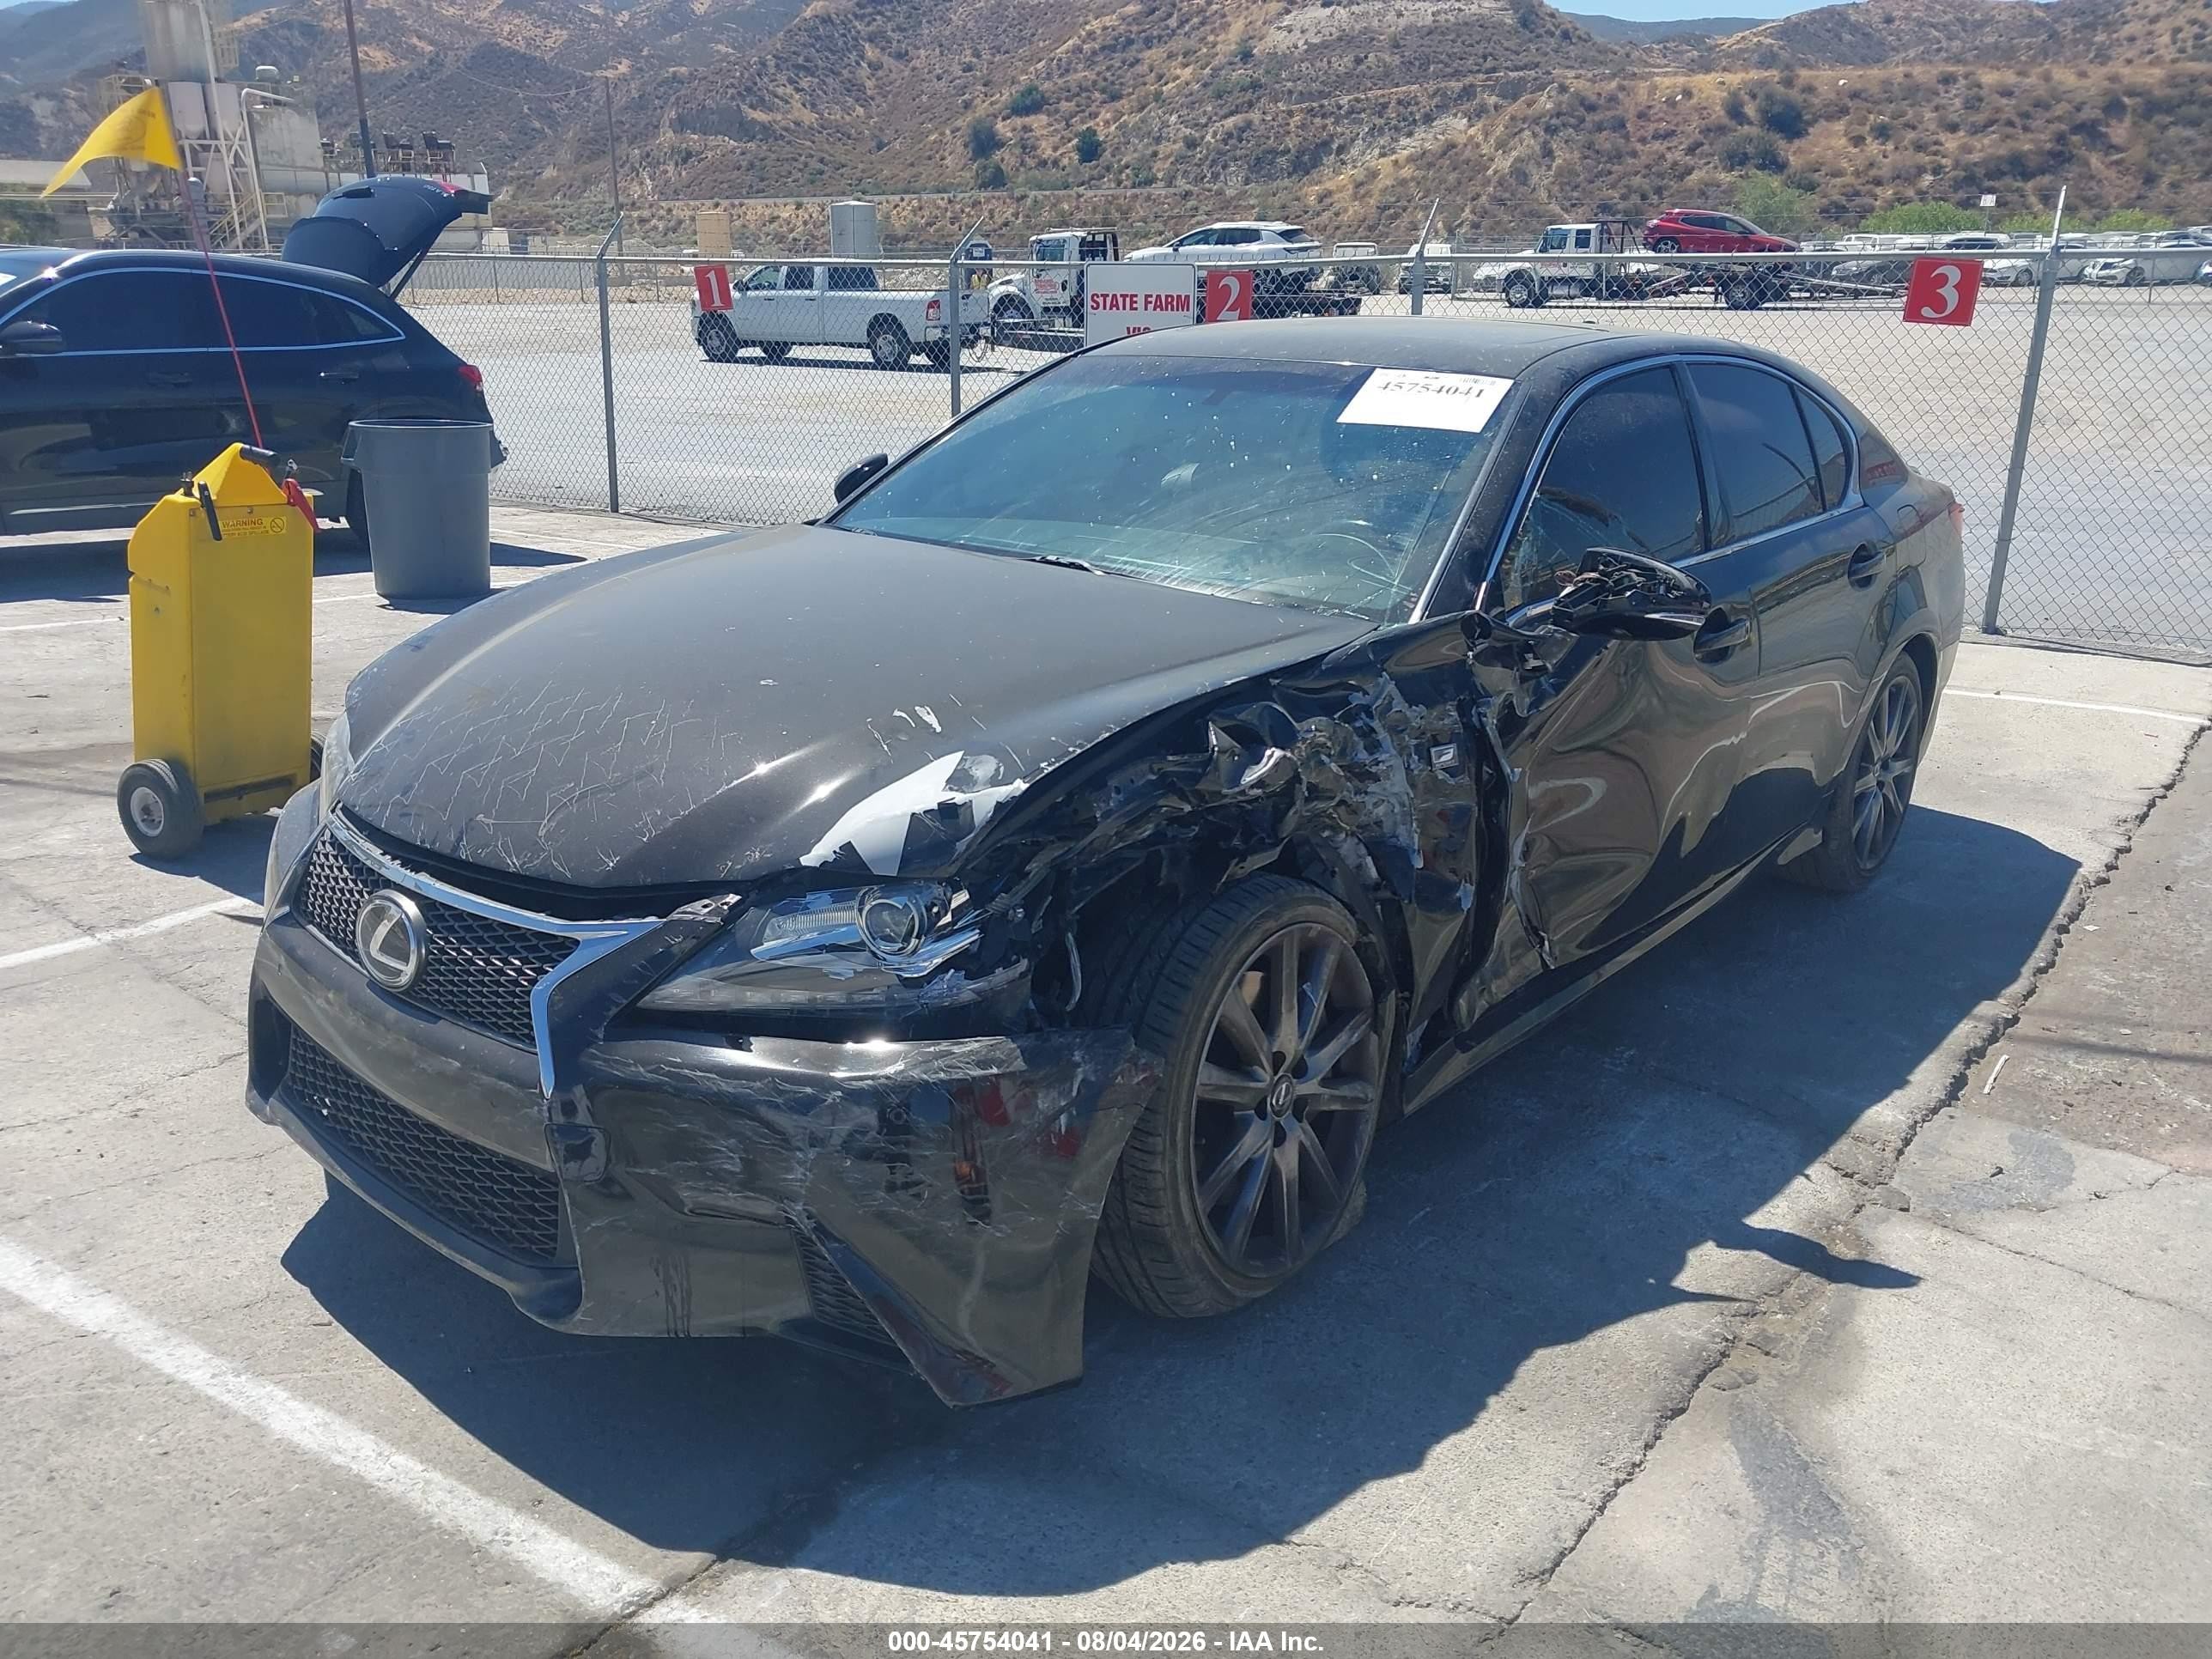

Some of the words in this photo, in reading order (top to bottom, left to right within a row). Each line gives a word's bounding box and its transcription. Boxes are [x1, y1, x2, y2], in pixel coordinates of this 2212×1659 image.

[704, 269, 726, 307] 1
[1216, 276, 1241, 321] 2
[1921, 264, 1962, 319] 3
[1091, 293, 1139, 312] STATE
[1144, 294, 1191, 313] FARM
[1377, 381, 1486, 398] 45754041
[222, 518, 264, 529] WARNING
